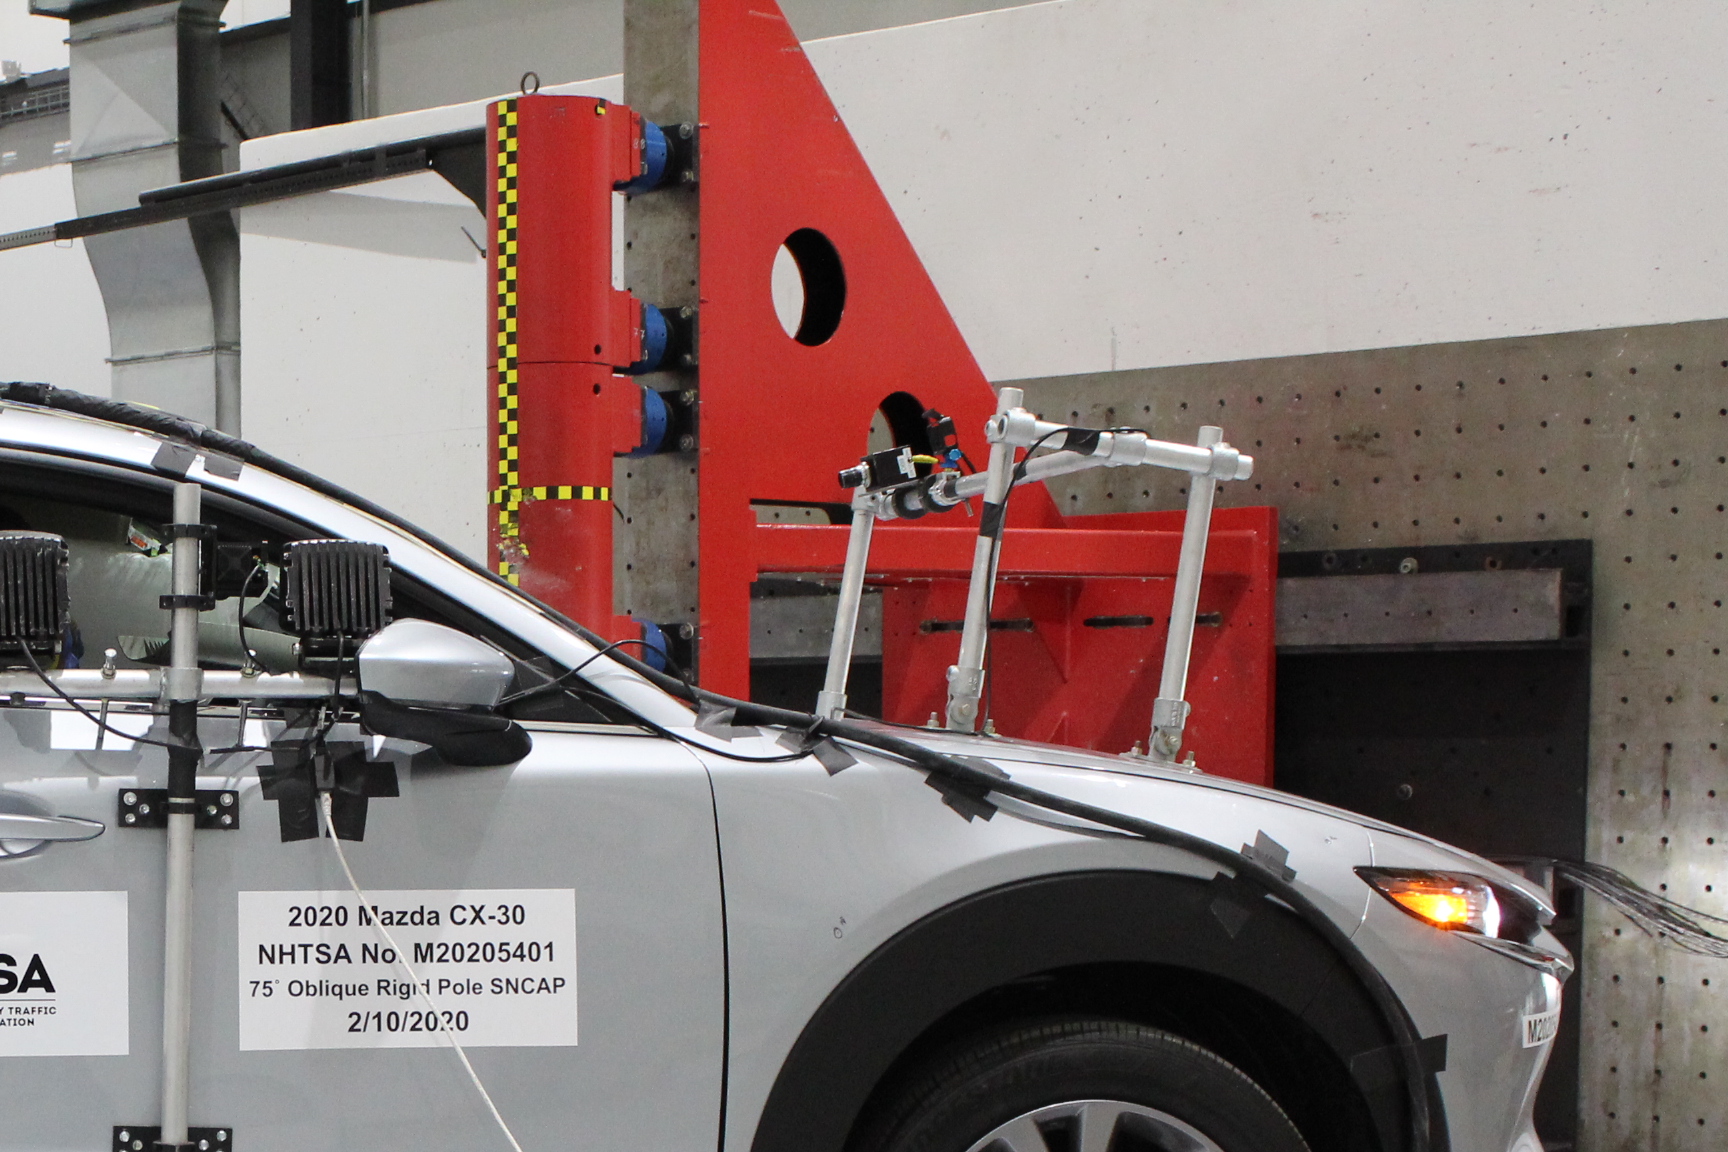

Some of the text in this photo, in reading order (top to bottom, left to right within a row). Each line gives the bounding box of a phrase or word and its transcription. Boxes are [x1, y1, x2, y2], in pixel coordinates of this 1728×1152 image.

[288, 904, 526, 927] 2020 Mazda CX-30
[259, 943, 353, 965] NHTSA
[414, 941, 554, 963] M20205401
[288, 979, 370, 1001] Oblique
[438, 978, 484, 996] Pole
[490, 977, 566, 995] SNCAP
[8, 1006, 57, 1015] TRAFFIC
[347, 1010, 469, 1033] 2/10/2020
